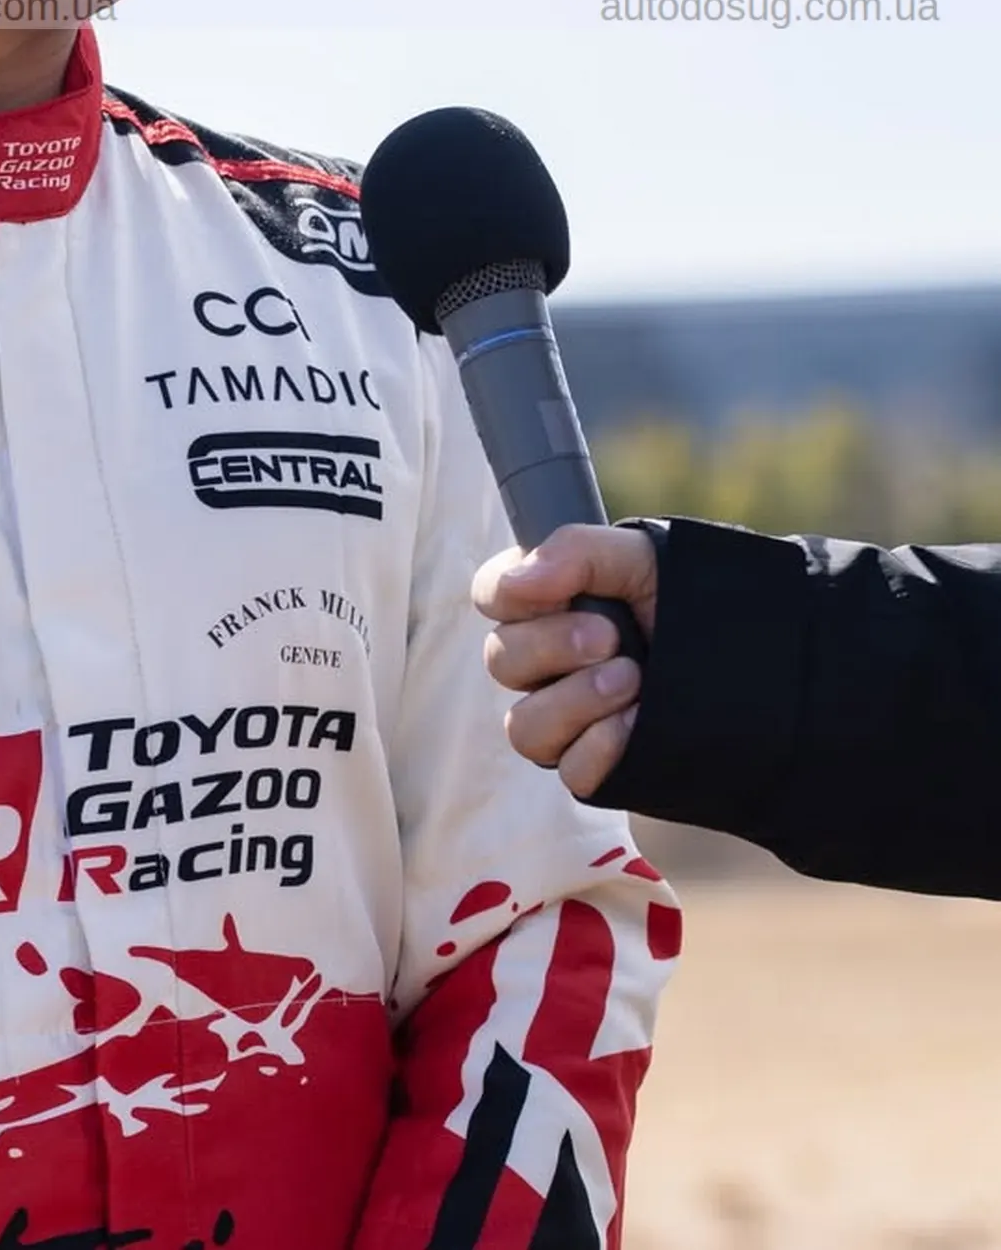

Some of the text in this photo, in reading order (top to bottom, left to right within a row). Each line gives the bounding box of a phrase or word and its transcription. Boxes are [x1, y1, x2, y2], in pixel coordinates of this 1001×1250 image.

[0, 155, 74, 174] GAZOO
[298, 207, 369, 261] OM
[190, 454, 382, 494] CENTRAL
[207, 586, 307, 649] FRANCK
[280, 644, 342, 668] GENEVE
[68, 705, 356, 772] TOYOTA
[65, 767, 321, 837] GAZOO
[57, 825, 314, 903] Racing
